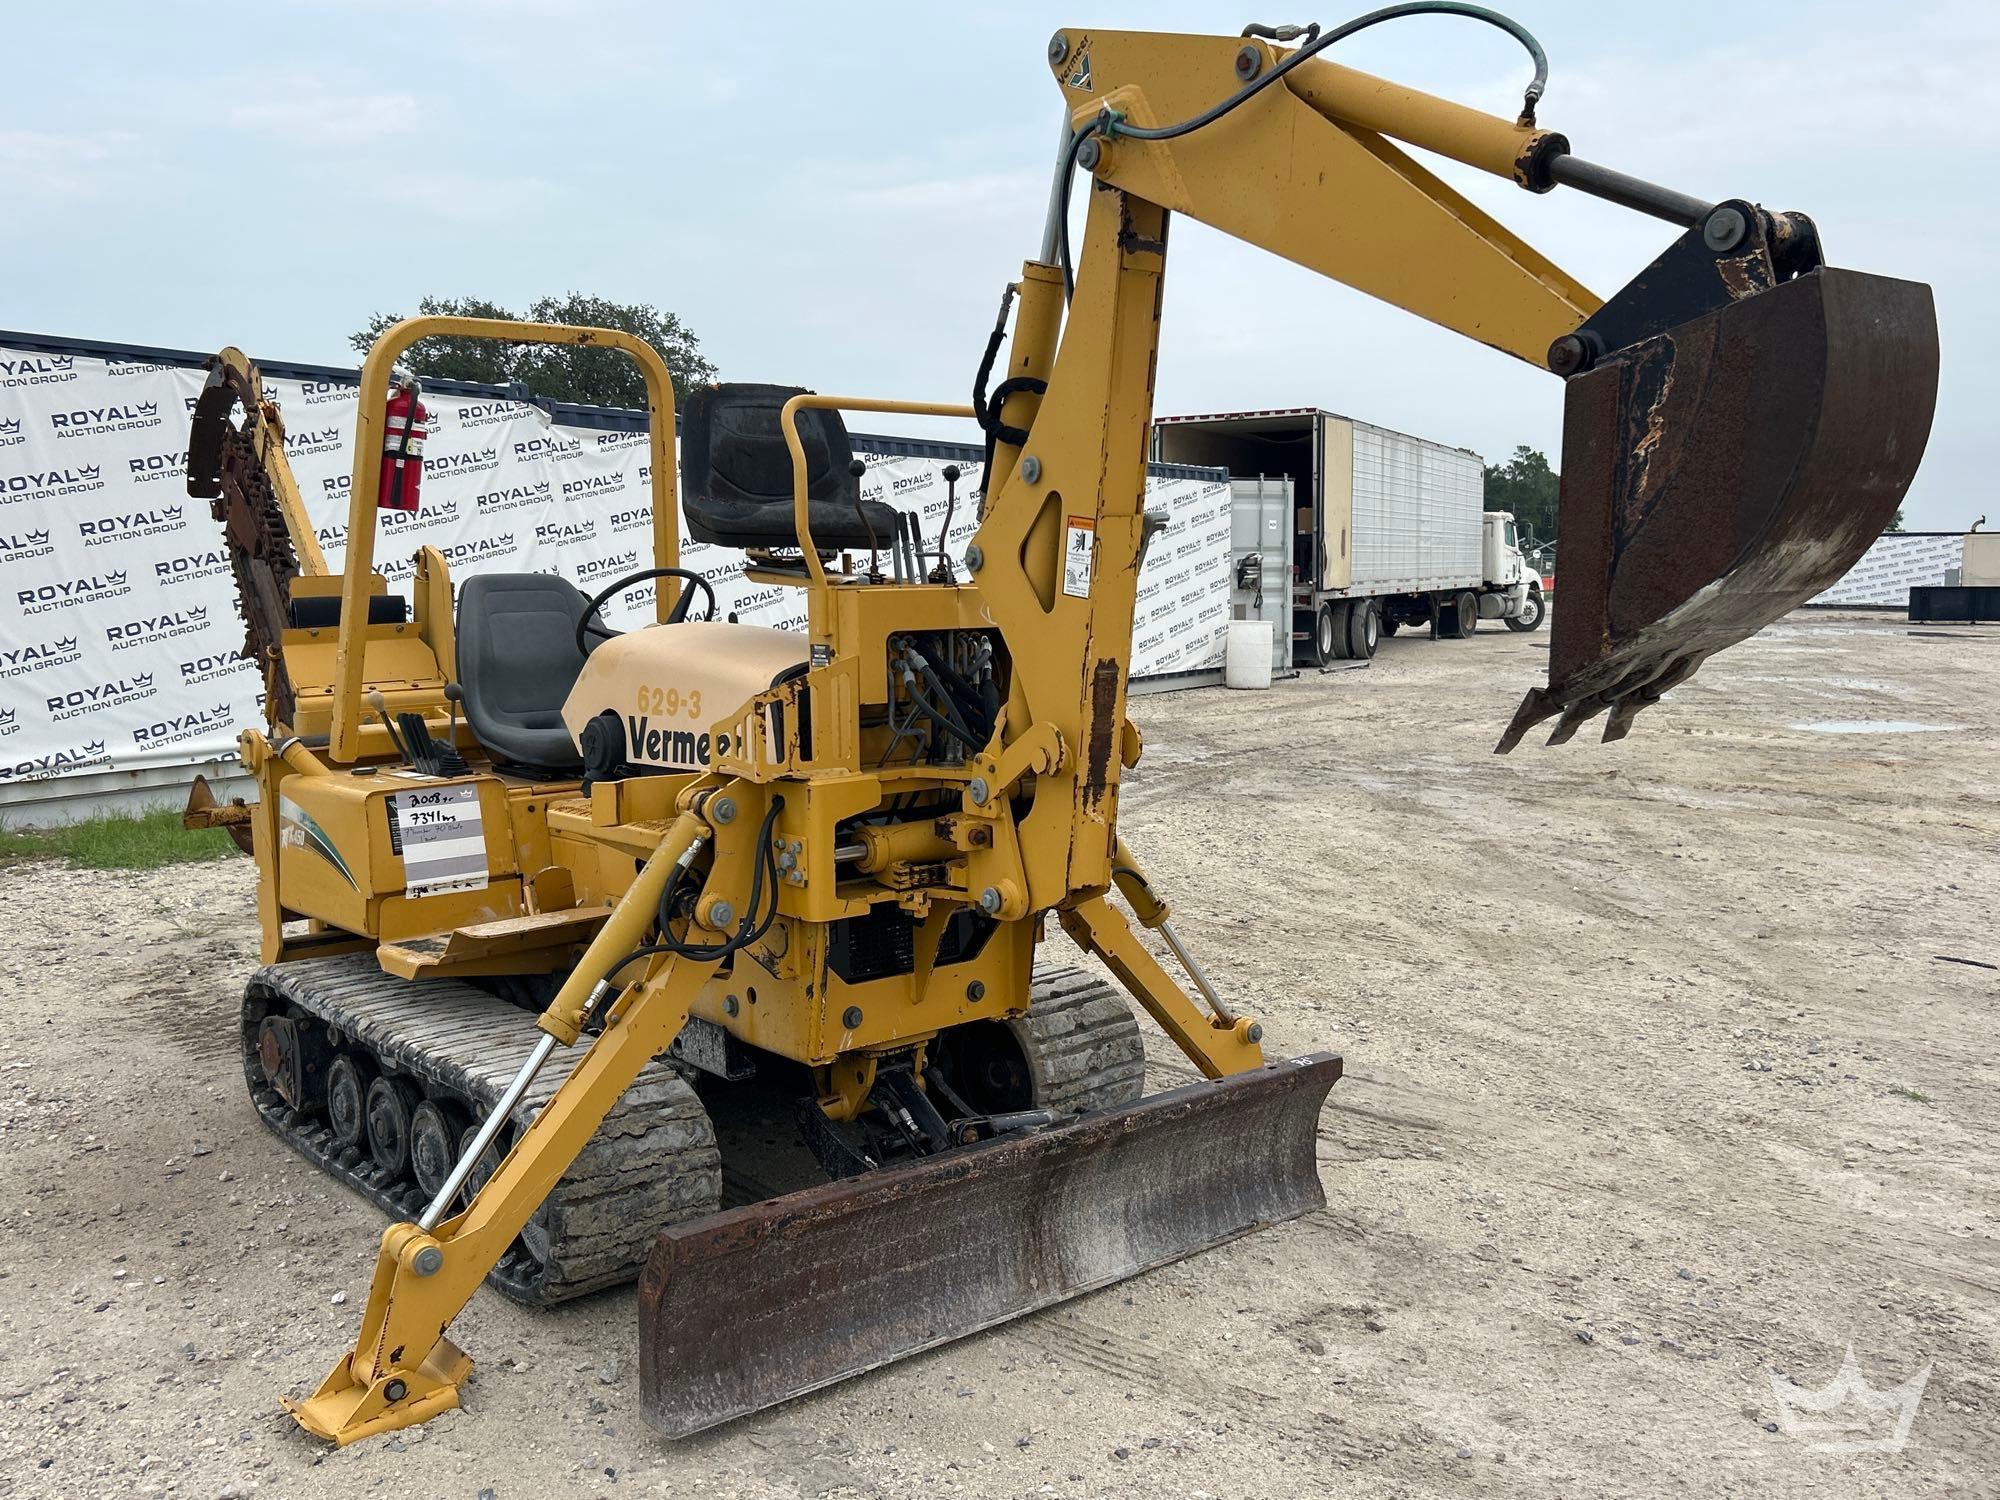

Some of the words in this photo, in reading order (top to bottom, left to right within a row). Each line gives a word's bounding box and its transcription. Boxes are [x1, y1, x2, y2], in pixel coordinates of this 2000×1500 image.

[1057, 34, 1089, 85] Vermeer
[0, 359, 51, 376] YAL
[30, 373, 78, 384] GROUP
[305, 393, 351, 405] AUCTION
[51, 406, 138, 428] ROYAL
[458, 402, 515, 420] ROYAL
[461, 415, 500, 428] AUCTION
[502, 410, 533, 421] GROUP
[56, 424, 116, 439] AUCTION
[118, 418, 162, 431] GROUP
[286, 432, 322, 448] YAL
[307, 442, 342, 455] GROUP
[600, 443, 632, 453] AUCTION
[424, 452, 482, 472] ROYAL
[556, 451, 584, 462] GROUP
[427, 468, 467, 480] AUCTION
[469, 461, 499, 473] GROUP
[58, 481, 105, 495] GROUP
[562, 475, 611, 494] ROYAL
[893, 474, 925, 490] ROYAL
[327, 489, 352, 500] AUCT
[477, 485, 535, 507] ROYAL
[565, 490, 599, 503] AUCTION
[600, 484, 626, 495] GROUP
[895, 486, 916, 496] AUCTION
[1173, 493, 1194, 505] ROYAL
[479, 502, 518, 516] AUCTION
[519, 494, 553, 507] GROUP
[924, 500, 949, 514] ROYA
[79, 510, 163, 536] ROYAL
[381, 506, 442, 527] ROYAL
[1191, 512, 1210, 523] ROYAL
[84, 529, 141, 547] AUCTION
[144, 521, 187, 536] GROUP
[384, 522, 426, 536] AUCTION
[428, 515, 460, 528] GROUP
[613, 520, 645, 533] AUCTION
[950, 522, 978, 538] ROYAL
[566, 532, 597, 545] GROUP
[1206, 530, 1225, 541] ROYAL
[5, 546, 54, 562] GROUP
[486, 546, 517, 559] GROUP
[1177, 543, 1196, 555] ROYAL
[155, 550, 231, 576] ROYAL
[576, 555, 625, 576] ROYAL
[1147, 555, 1166, 567] ROYAL
[1195, 560, 1213, 572] ROYAL
[159, 568, 213, 586] AUCTION
[579, 571, 612, 583] AUCTION
[613, 562, 639, 575] GROUP
[1165, 573, 1184, 585] ROYAL
[17, 577, 106, 605] ROYAL
[1210, 577, 1228, 589] ROYAL
[23, 596, 84, 616] AUCTION
[86, 586, 131, 602] GROUP
[624, 587, 656, 604] ROY
[734, 590, 774, 609] ROYAL
[1181, 591, 1199, 603] ROYAL
[1151, 604, 1170, 616] ROYAL
[1198, 607, 1217, 619] ROYAL
[106, 612, 188, 641] ROYAL
[1169, 622, 1189, 634] ROYAL
[112, 631, 167, 651] AUCTION
[169, 621, 211, 638] GROUP
[1139, 636, 1158, 649] ROYAL
[1185, 638, 1204, 651] ROYAL
[0, 643, 56, 668] YAL
[34, 652, 82, 670] GROUP
[180, 650, 242, 676] ROYA
[1156, 652, 1175, 665] ROYAL
[185, 666, 236, 686] AUCTION
[47, 680, 133, 712] ROYAL
[52, 700, 111, 722] AUCTION
[113, 687, 158, 705] GROUP
[637, 685, 701, 719] 629-3
[133, 711, 212, 742] ROYAL
[140, 732, 191, 752] AUCTION
[194, 718, 235, 735] GROUP
[63, 755, 112, 773] GROUP
[409, 792, 441, 807] 2008
